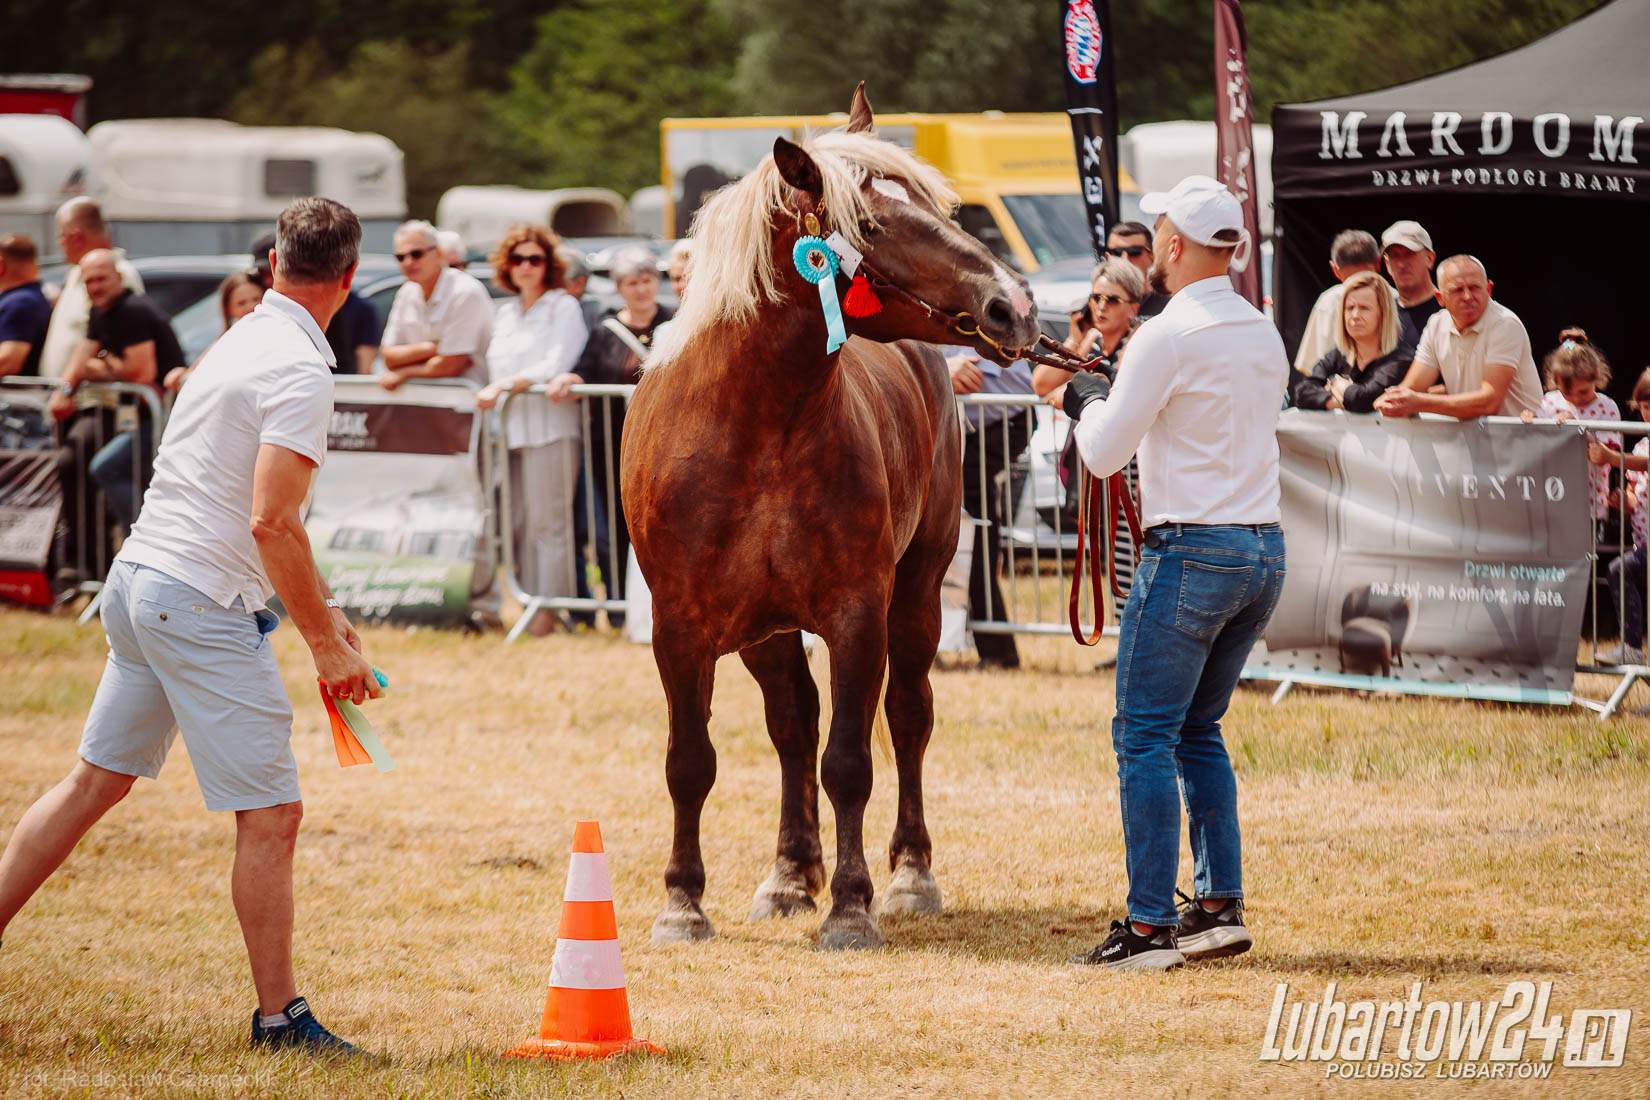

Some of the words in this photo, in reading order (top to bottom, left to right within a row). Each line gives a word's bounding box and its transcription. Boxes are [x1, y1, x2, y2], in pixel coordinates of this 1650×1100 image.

[1318, 111, 1644, 163] MARDOM
[1372, 168, 1440, 187] DRZWI
[1559, 171, 1636, 193] BRAMY
[1464, 560, 1506, 579] Drzwi
[1510, 563, 1567, 583] otwarte
[1370, 581, 1388, 596] na
[1428, 584, 1445, 599] na
[1513, 588, 1530, 604] na
